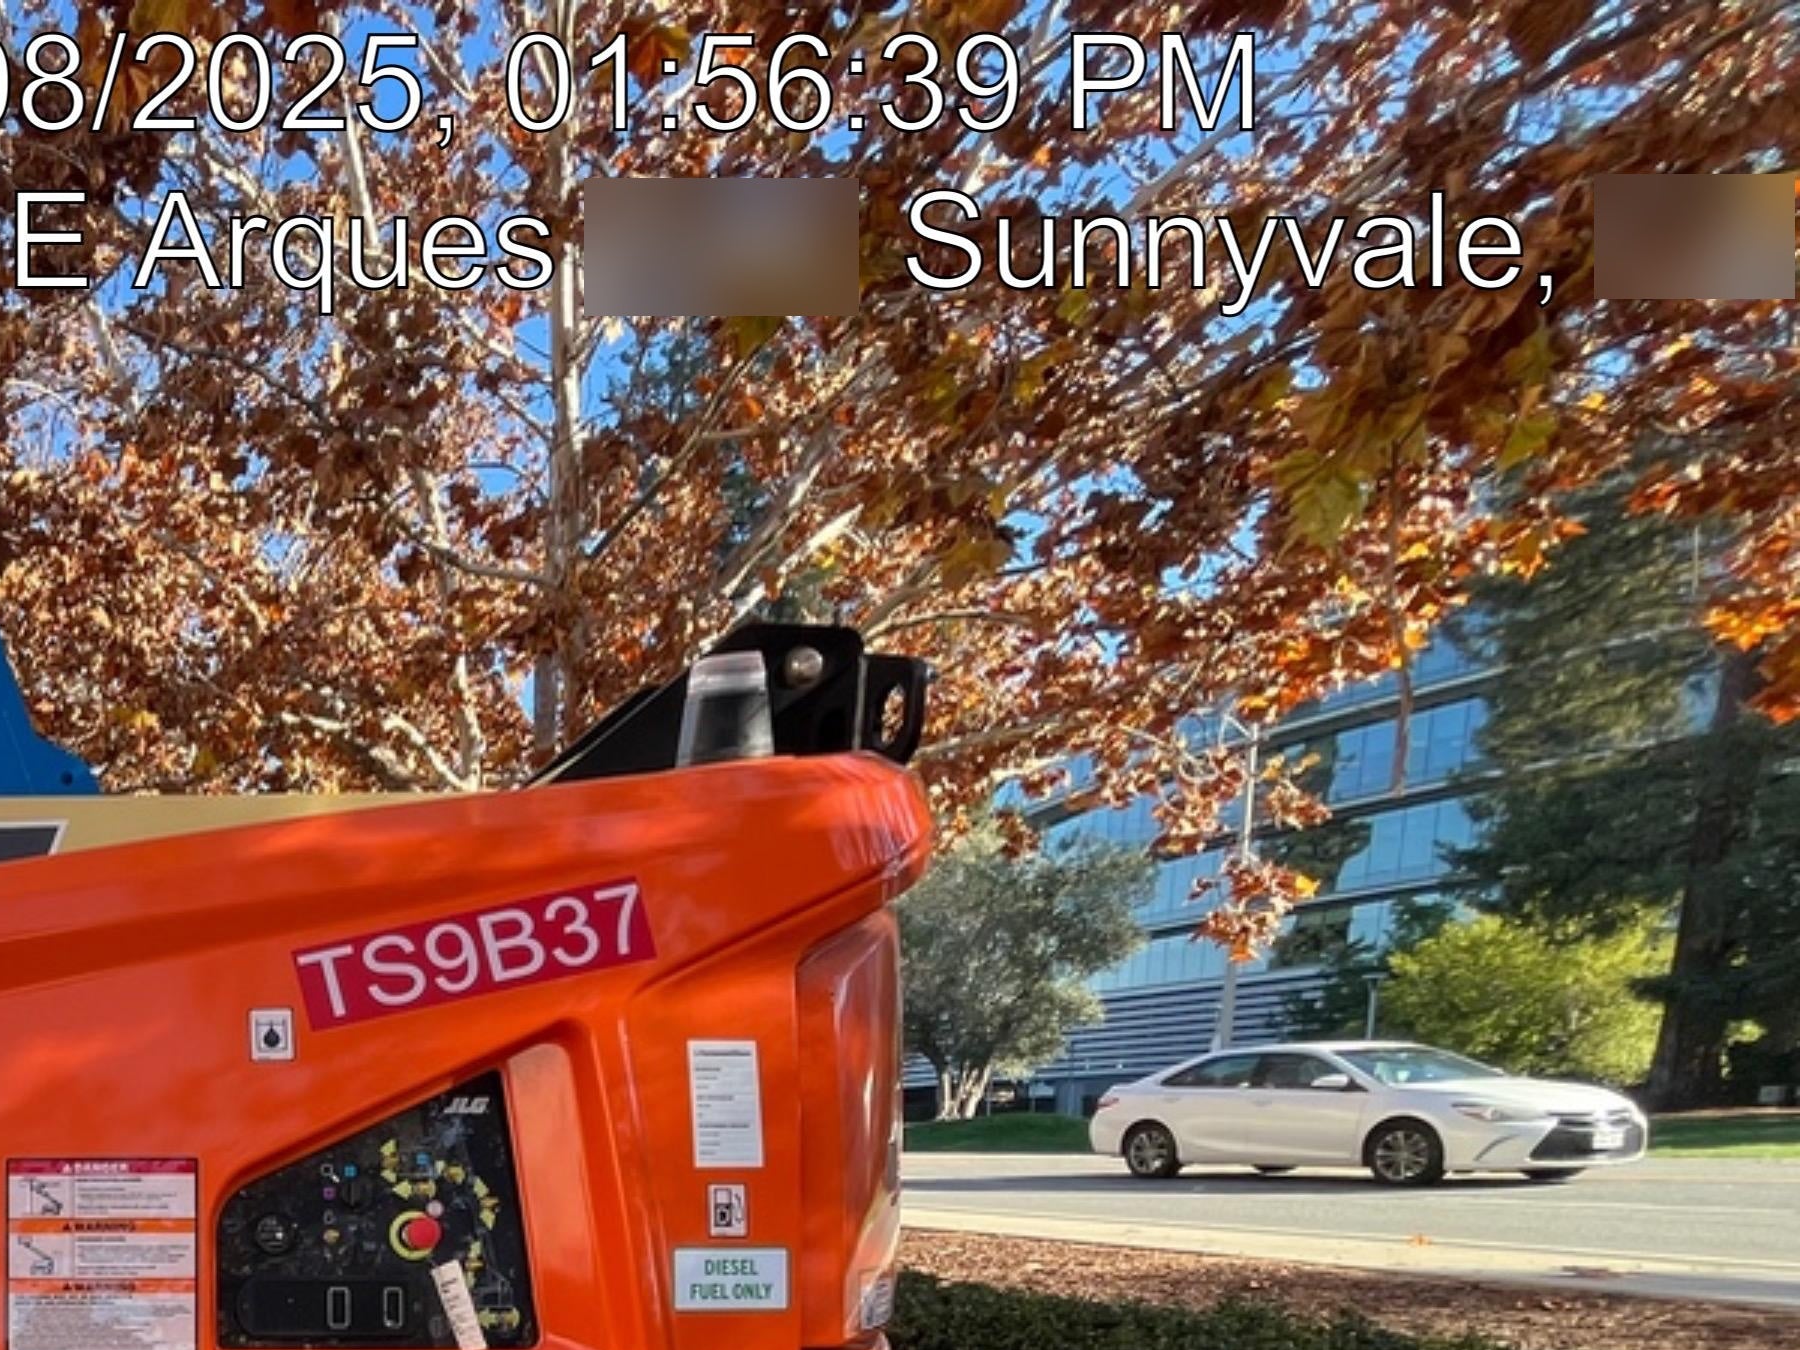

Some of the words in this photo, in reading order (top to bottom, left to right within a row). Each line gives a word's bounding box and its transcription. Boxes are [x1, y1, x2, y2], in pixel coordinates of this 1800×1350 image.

[296, 882, 642, 1019] TS9B37
[443, 1096, 490, 1114] JLG
[74, 1223, 137, 1234] WARNING
[704, 1258, 759, 1276] DIESEL
[690, 1283, 728, 1300] FUEL
[731, 1283, 773, 1300] ONLY
